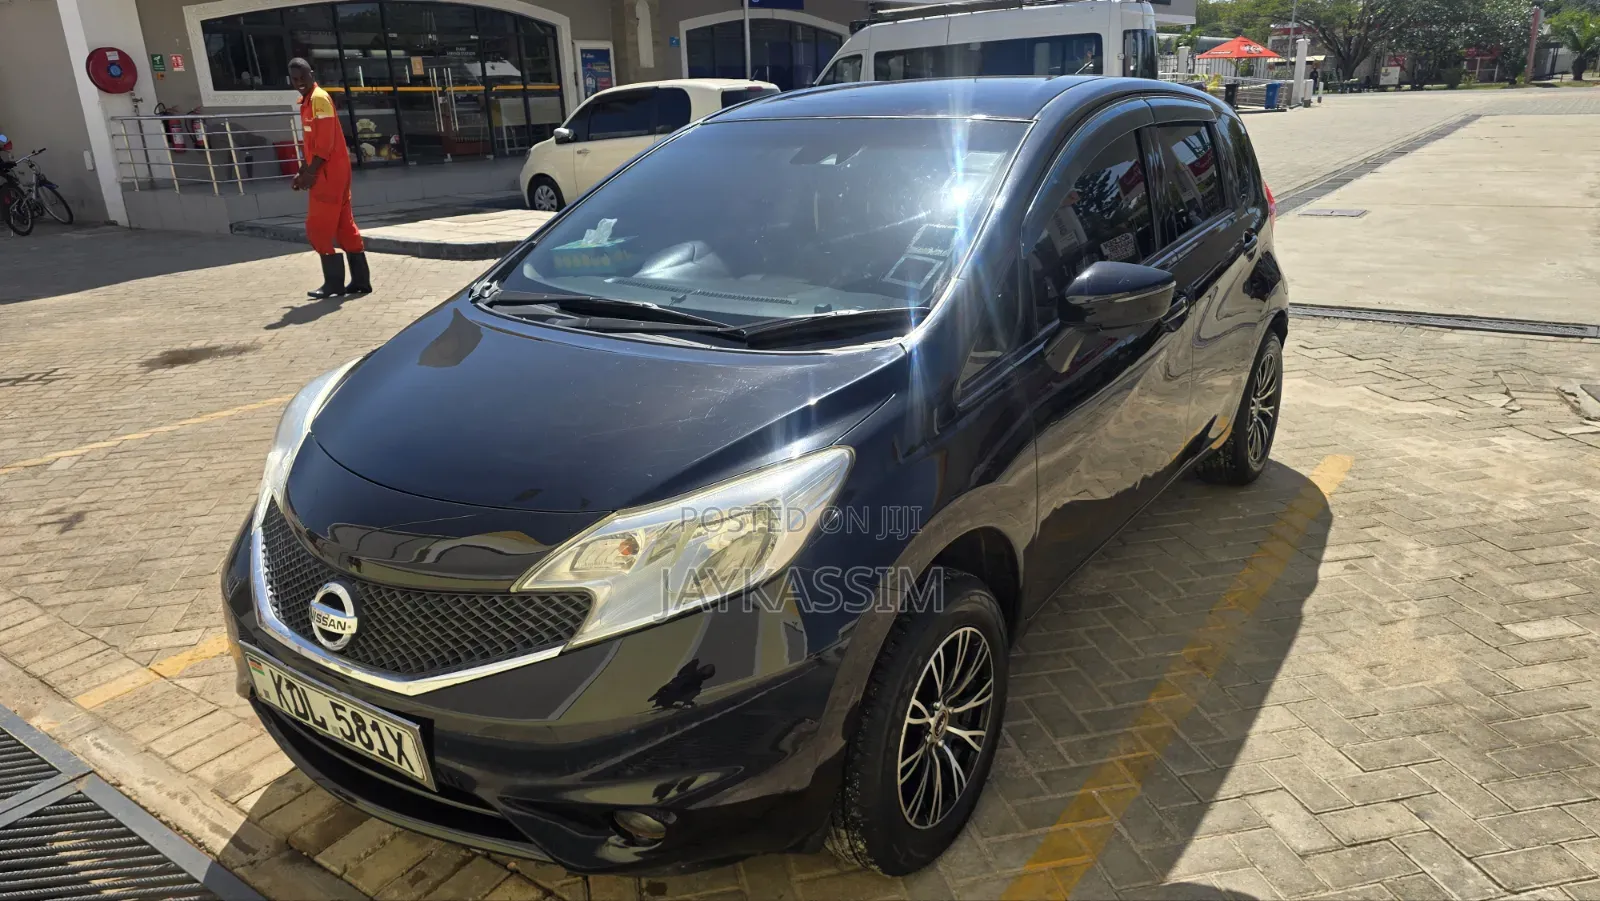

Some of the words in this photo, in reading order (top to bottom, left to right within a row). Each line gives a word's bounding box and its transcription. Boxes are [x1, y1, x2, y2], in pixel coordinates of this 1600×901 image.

[311, 609, 347, 631] NISSAN
[269, 668, 329, 731] KDL
[329, 700, 416, 773] 581X
